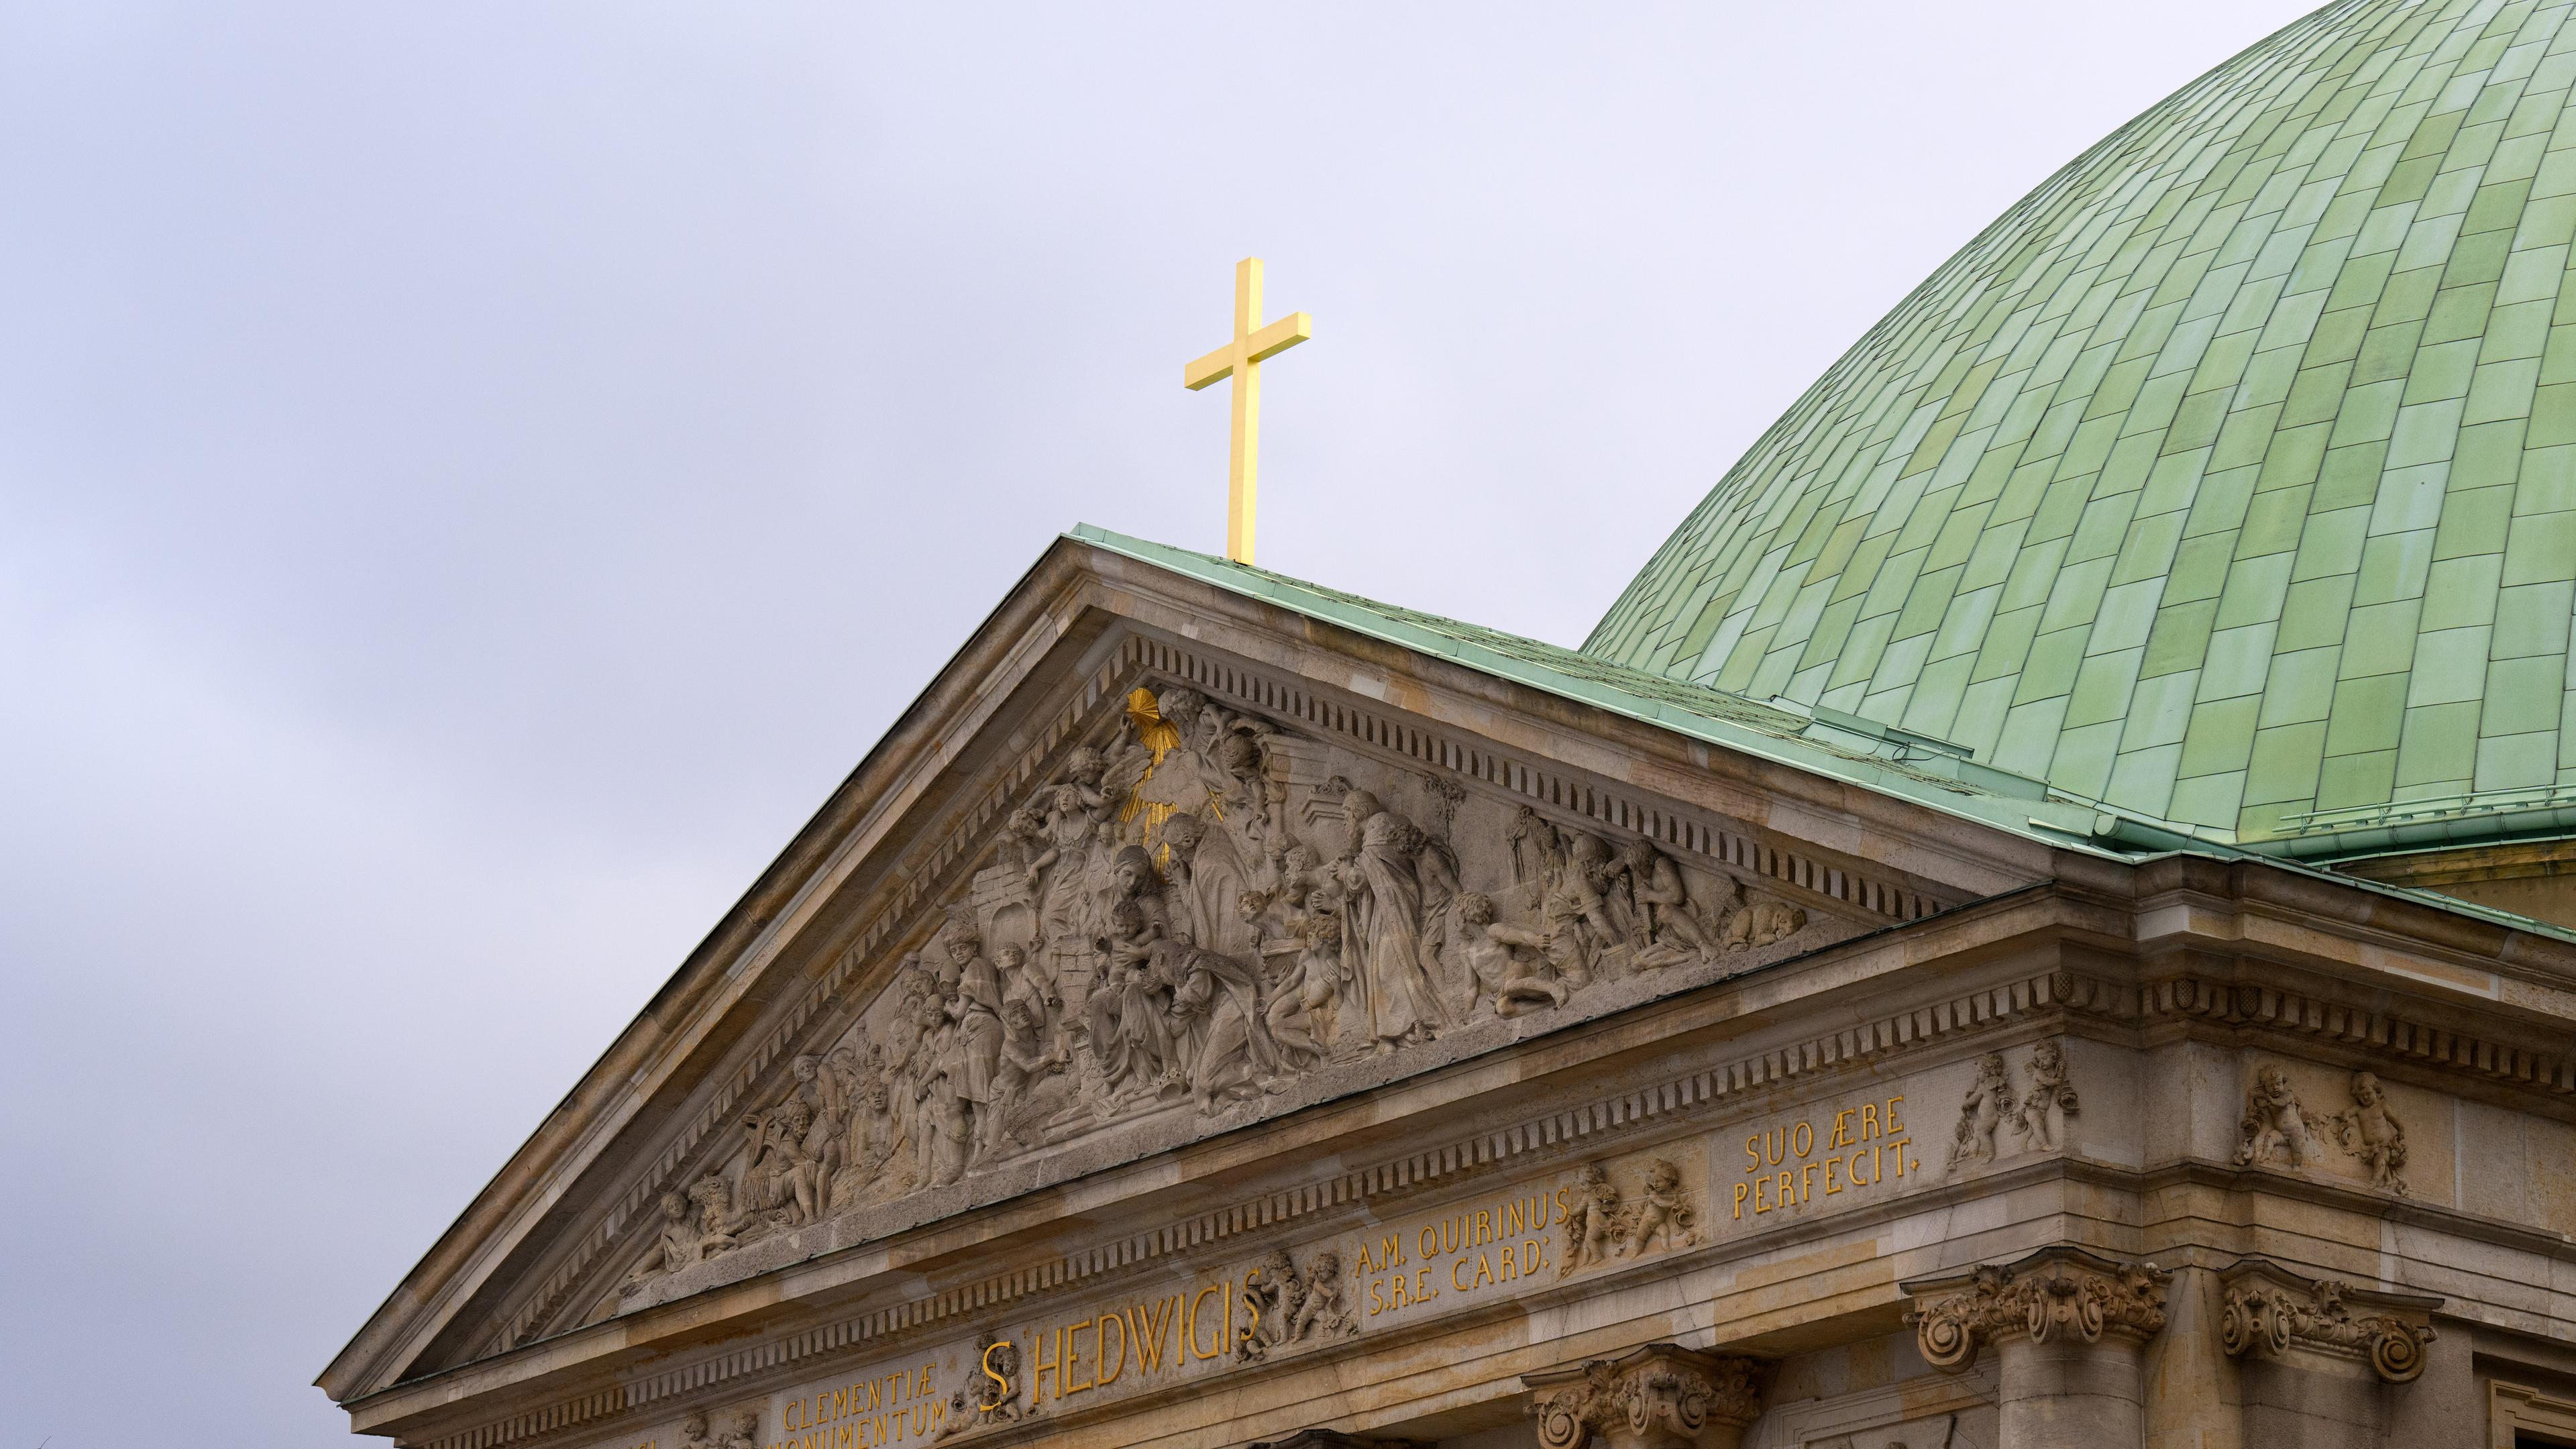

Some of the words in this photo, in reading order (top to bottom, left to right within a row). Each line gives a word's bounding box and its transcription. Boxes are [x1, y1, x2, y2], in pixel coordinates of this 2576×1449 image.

[1746, 1122, 1814, 1173] SUO
[1828, 1095, 1904, 1149] ÆRE
[1733, 1137, 1919, 1220] PERFECIT.
[1355, 1233, 1407, 1277] A.M.
[1417, 1186, 1570, 1259] QUIRINUS
[1370, 1266, 1439, 1316] S.R.E.
[1033, 1267, 1261, 1404] HEDWIGIS
[783, 1362, 936, 1432] CLEMENTIÆ
